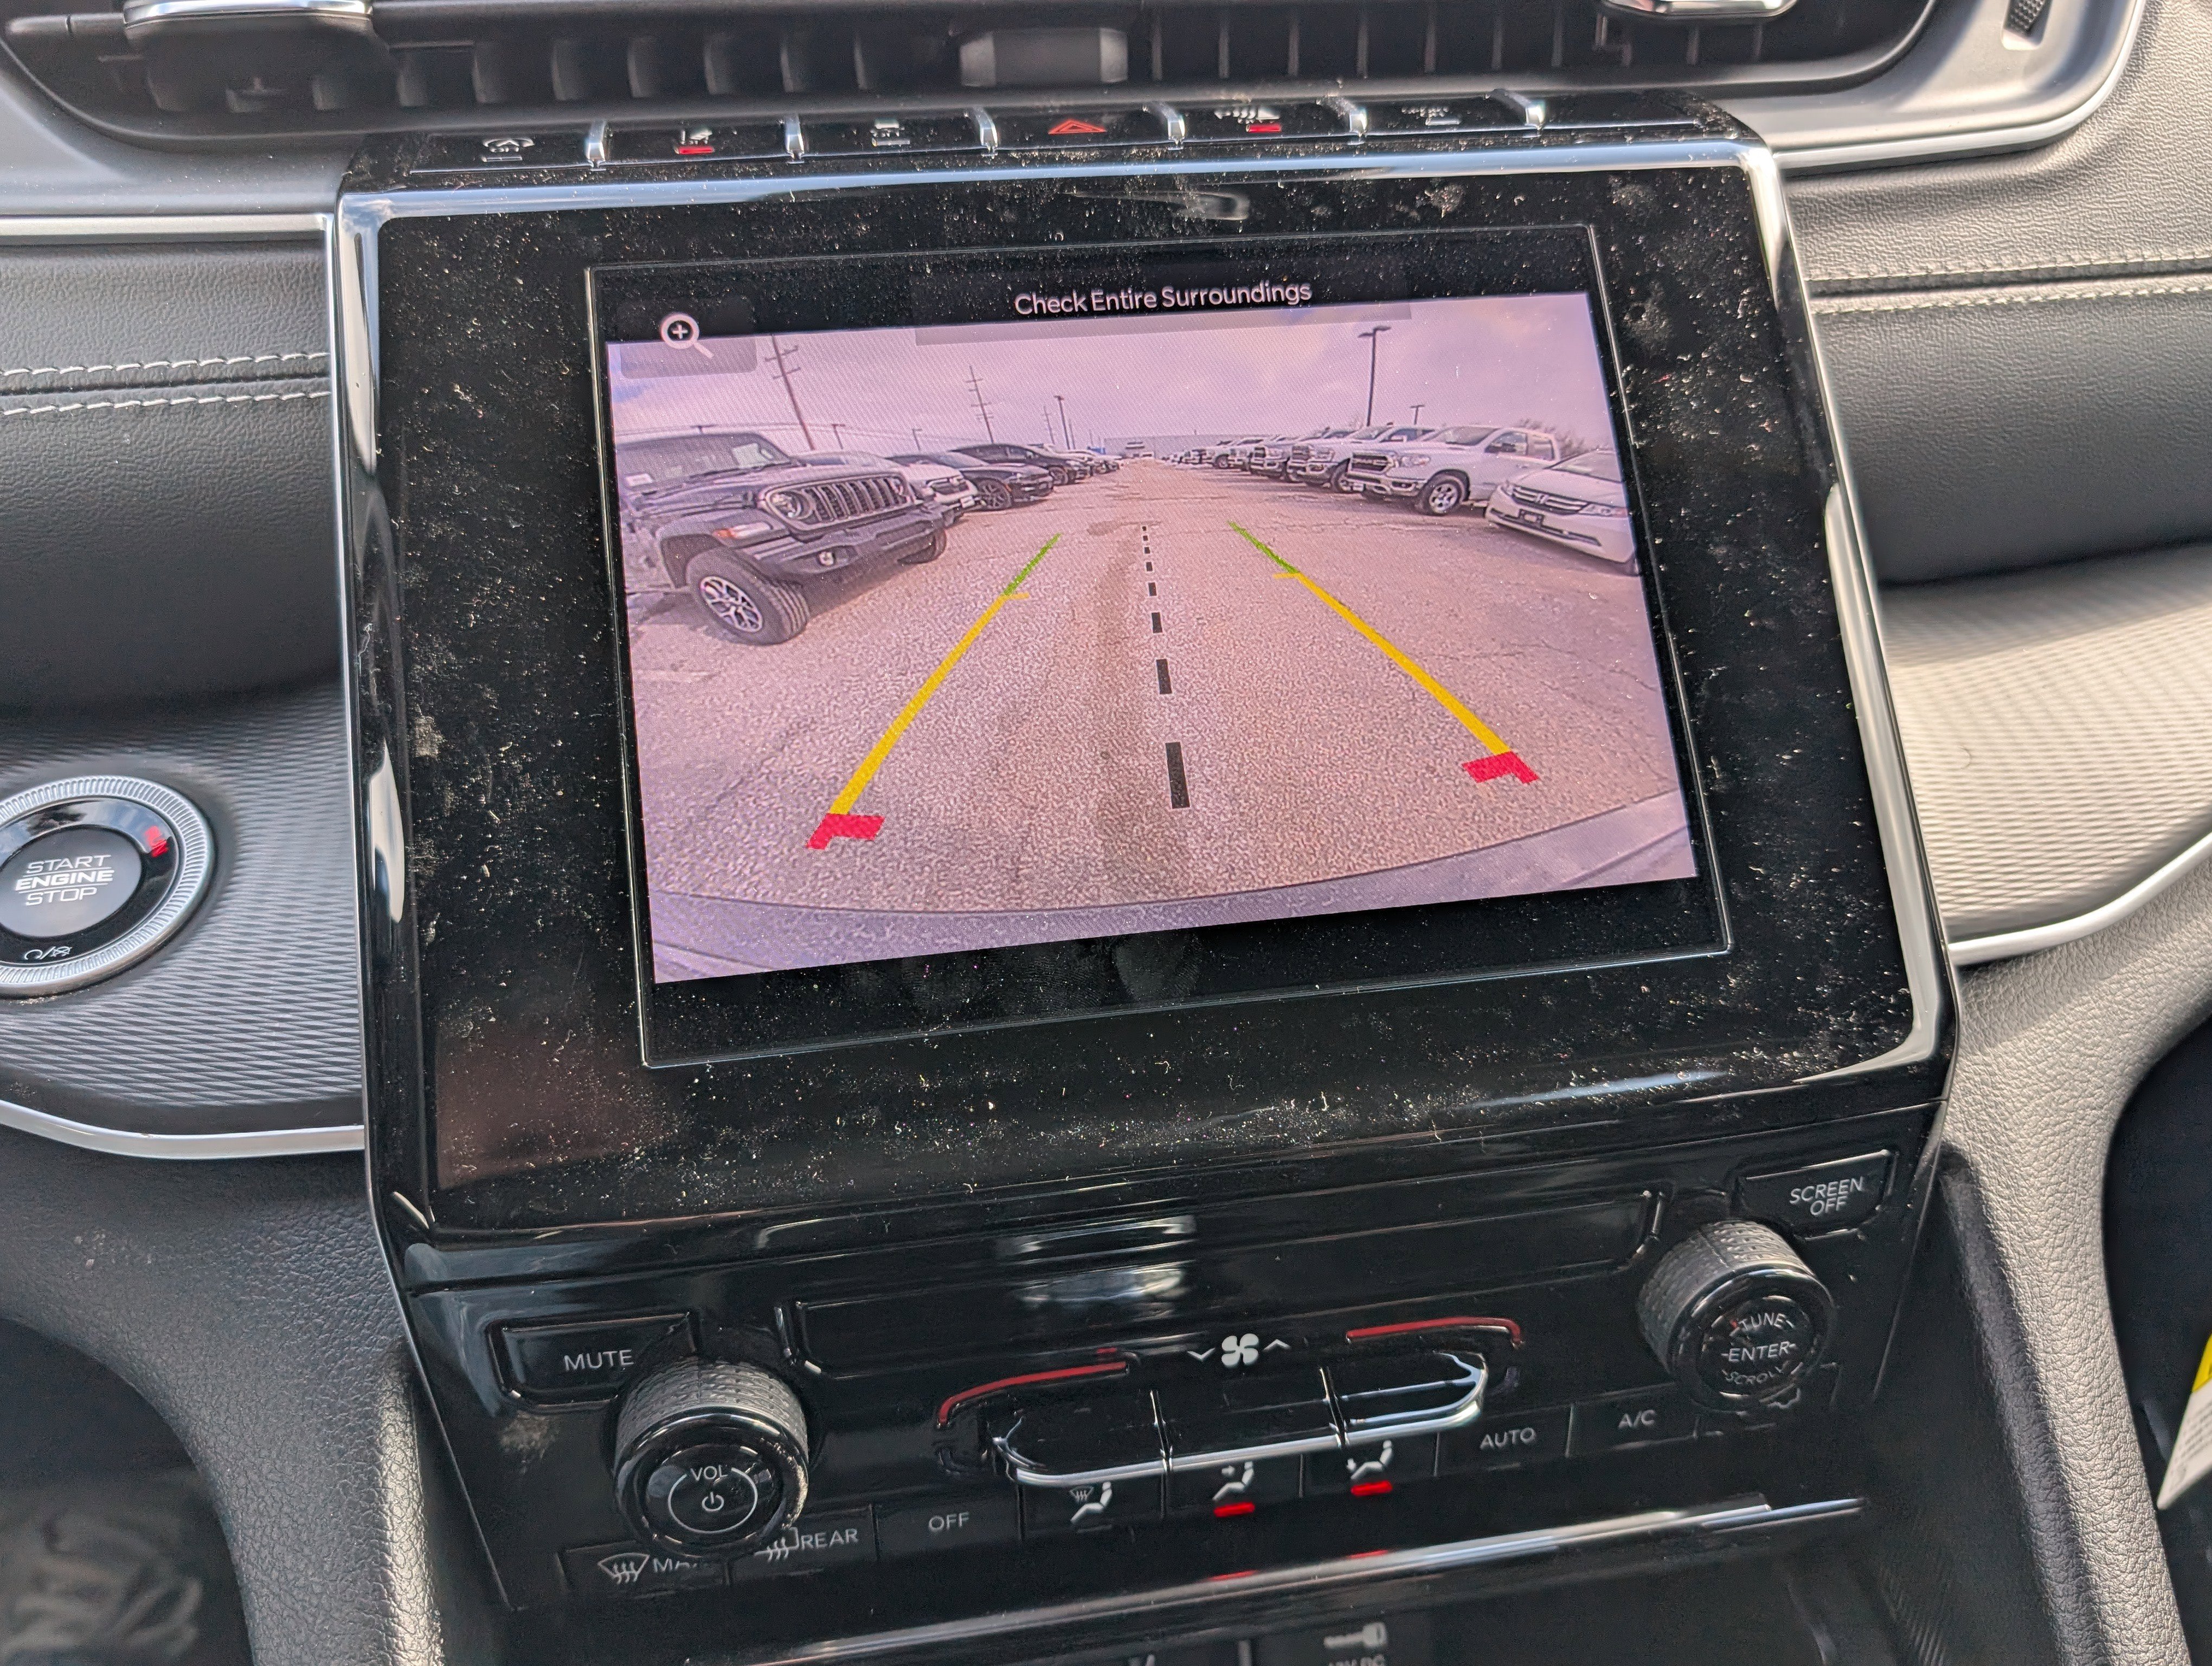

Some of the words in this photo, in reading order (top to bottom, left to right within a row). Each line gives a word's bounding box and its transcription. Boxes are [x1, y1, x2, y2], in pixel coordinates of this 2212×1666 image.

[1014, 291, 1088, 315] Check
[1090, 287, 1158, 311] Entire
[1161, 280, 1313, 308] Surroundings
[26, 854, 111, 874] START
[15, 869, 115, 892] ENGINE
[25, 887, 98, 906] STOP
[1789, 1176, 1864, 1205] SCREEN
[1810, 1195, 1848, 1216] OFF
[1738, 1312, 1787, 1331] TUNE
[563, 1349, 635, 1372] MUTE
[1728, 1341, 1791, 1362] ENTER
[1618, 1409, 1656, 1429] A/C
[1480, 1426, 1536, 1450] AUTO
[690, 1464, 729, 1482] VOL
[928, 1511, 970, 1533] OFF
[800, 1528, 859, 1551] REAR
